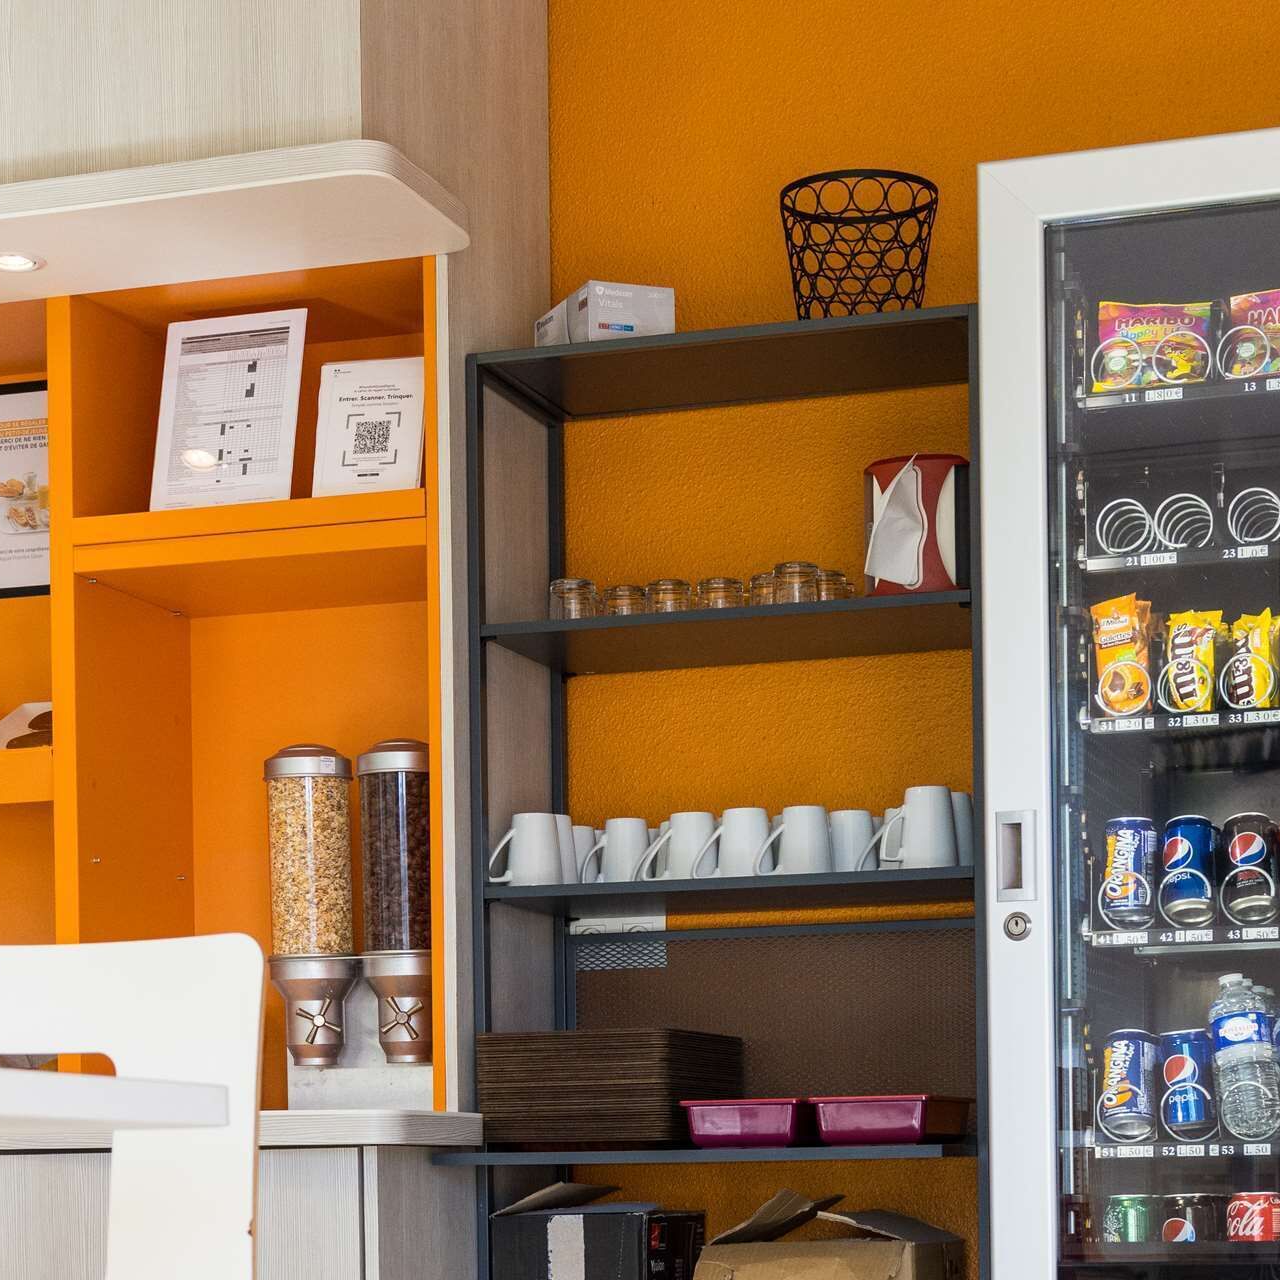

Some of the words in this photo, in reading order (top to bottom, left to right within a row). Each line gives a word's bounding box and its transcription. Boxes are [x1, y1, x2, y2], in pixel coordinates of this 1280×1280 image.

[1243, 382, 1257, 391] 13
[1124, 394, 1138, 403] 11
[1222, 549, 1236, 559] 23
[1125, 556, 1139, 566] 21
[1168, 717, 1181, 727] 32
[1228, 714, 1242, 723] 33
[1100, 721, 1113, 731] 31
[1160, 932, 1174, 942] 42
[1226, 929, 1241, 939] 43
[1168, 1094, 1199, 1105] pepsi
[1102, 1148, 1115, 1157] 51
[1162, 1147, 1175, 1156] 52
[1221, 1146, 1235, 1154] 53
